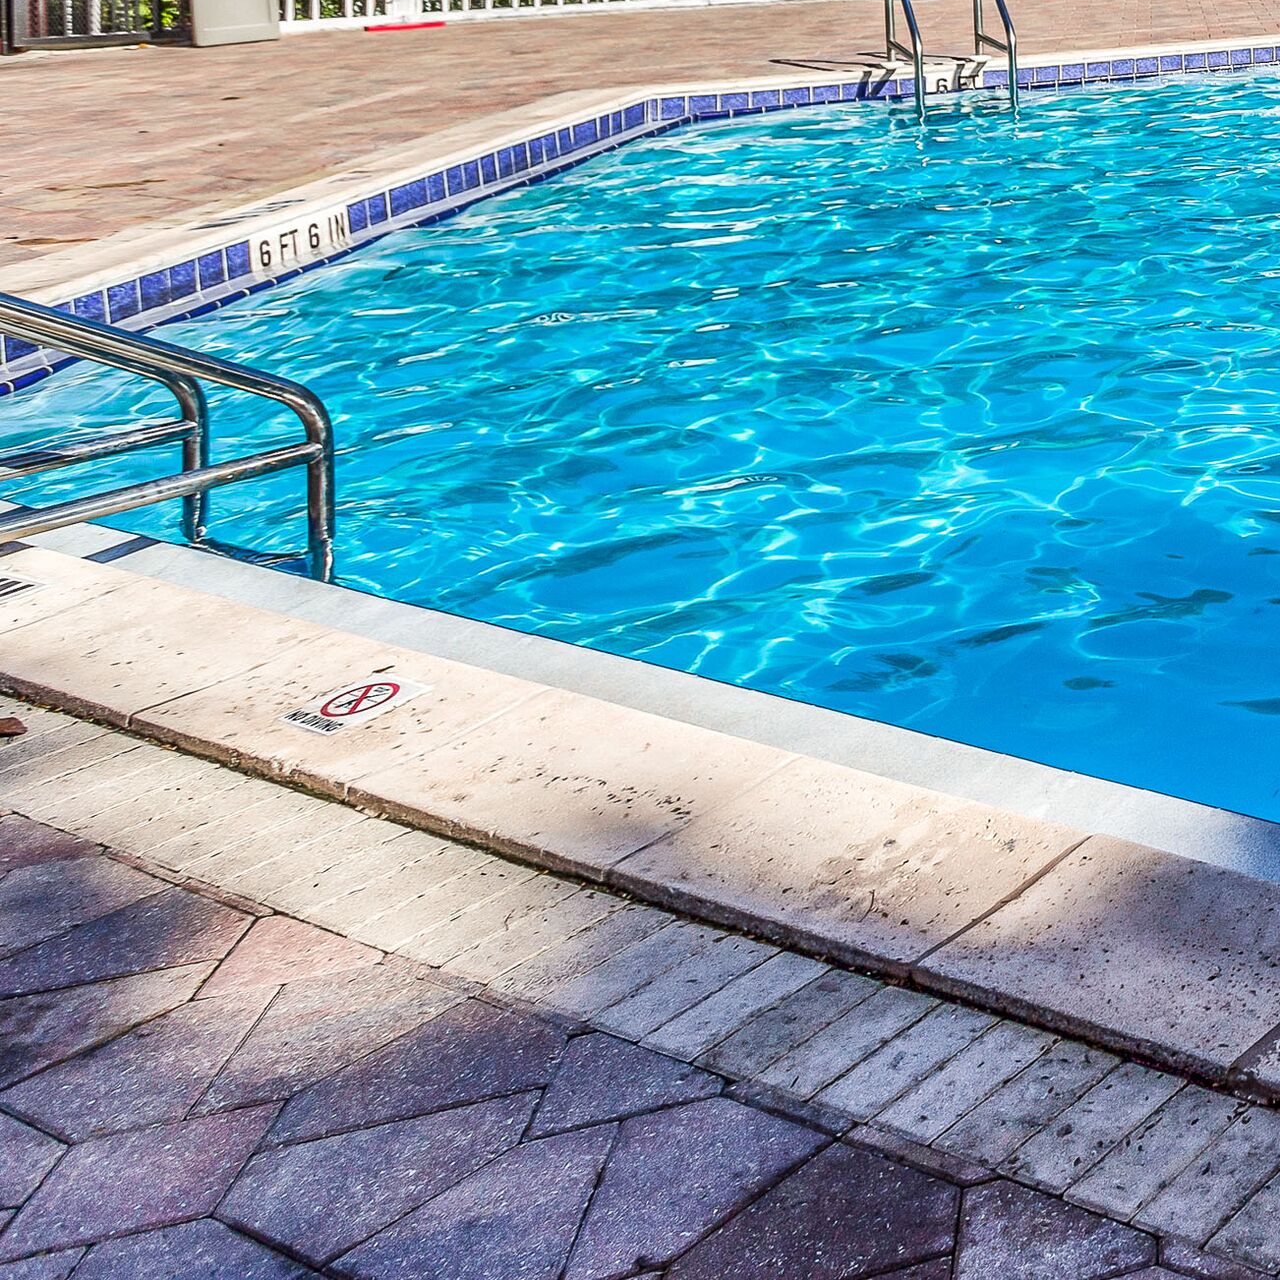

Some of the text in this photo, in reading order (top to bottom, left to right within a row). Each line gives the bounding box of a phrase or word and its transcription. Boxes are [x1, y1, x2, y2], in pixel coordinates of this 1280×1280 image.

[936, 78, 948, 93] 6
[259, 240, 271, 267] 6
[279, 229, 298, 262] FT
[308, 223, 320, 249] 6
[328, 212, 346, 243] IN
[284, 710, 344, 732] NO DIVING
